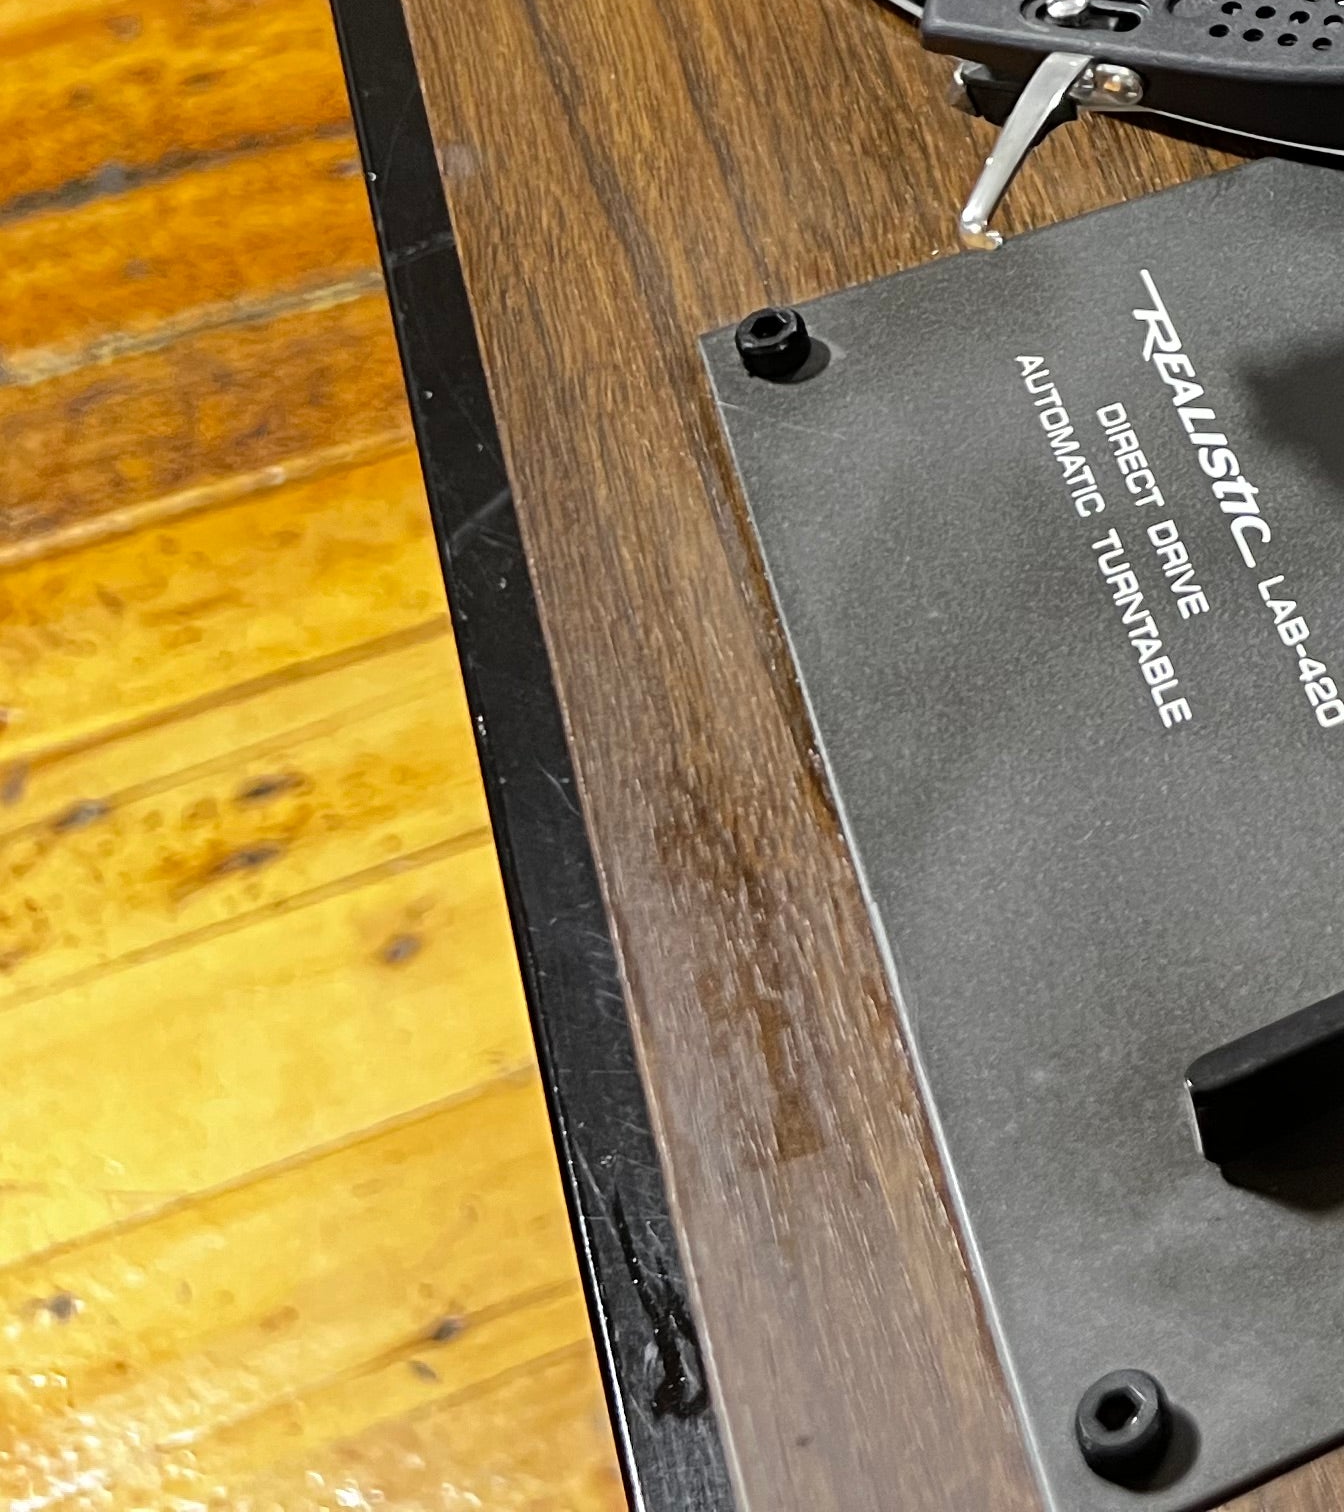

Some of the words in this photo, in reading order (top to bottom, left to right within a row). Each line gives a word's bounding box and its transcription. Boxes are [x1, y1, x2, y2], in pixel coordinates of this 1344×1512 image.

[1014, 355, 1105, 518] AUTOMATIC
[1092, 528, 1193, 728] TURNTABLE
[1096, 402, 1164, 508] DIRECT
[1147, 520, 1210, 620] DRIVE
